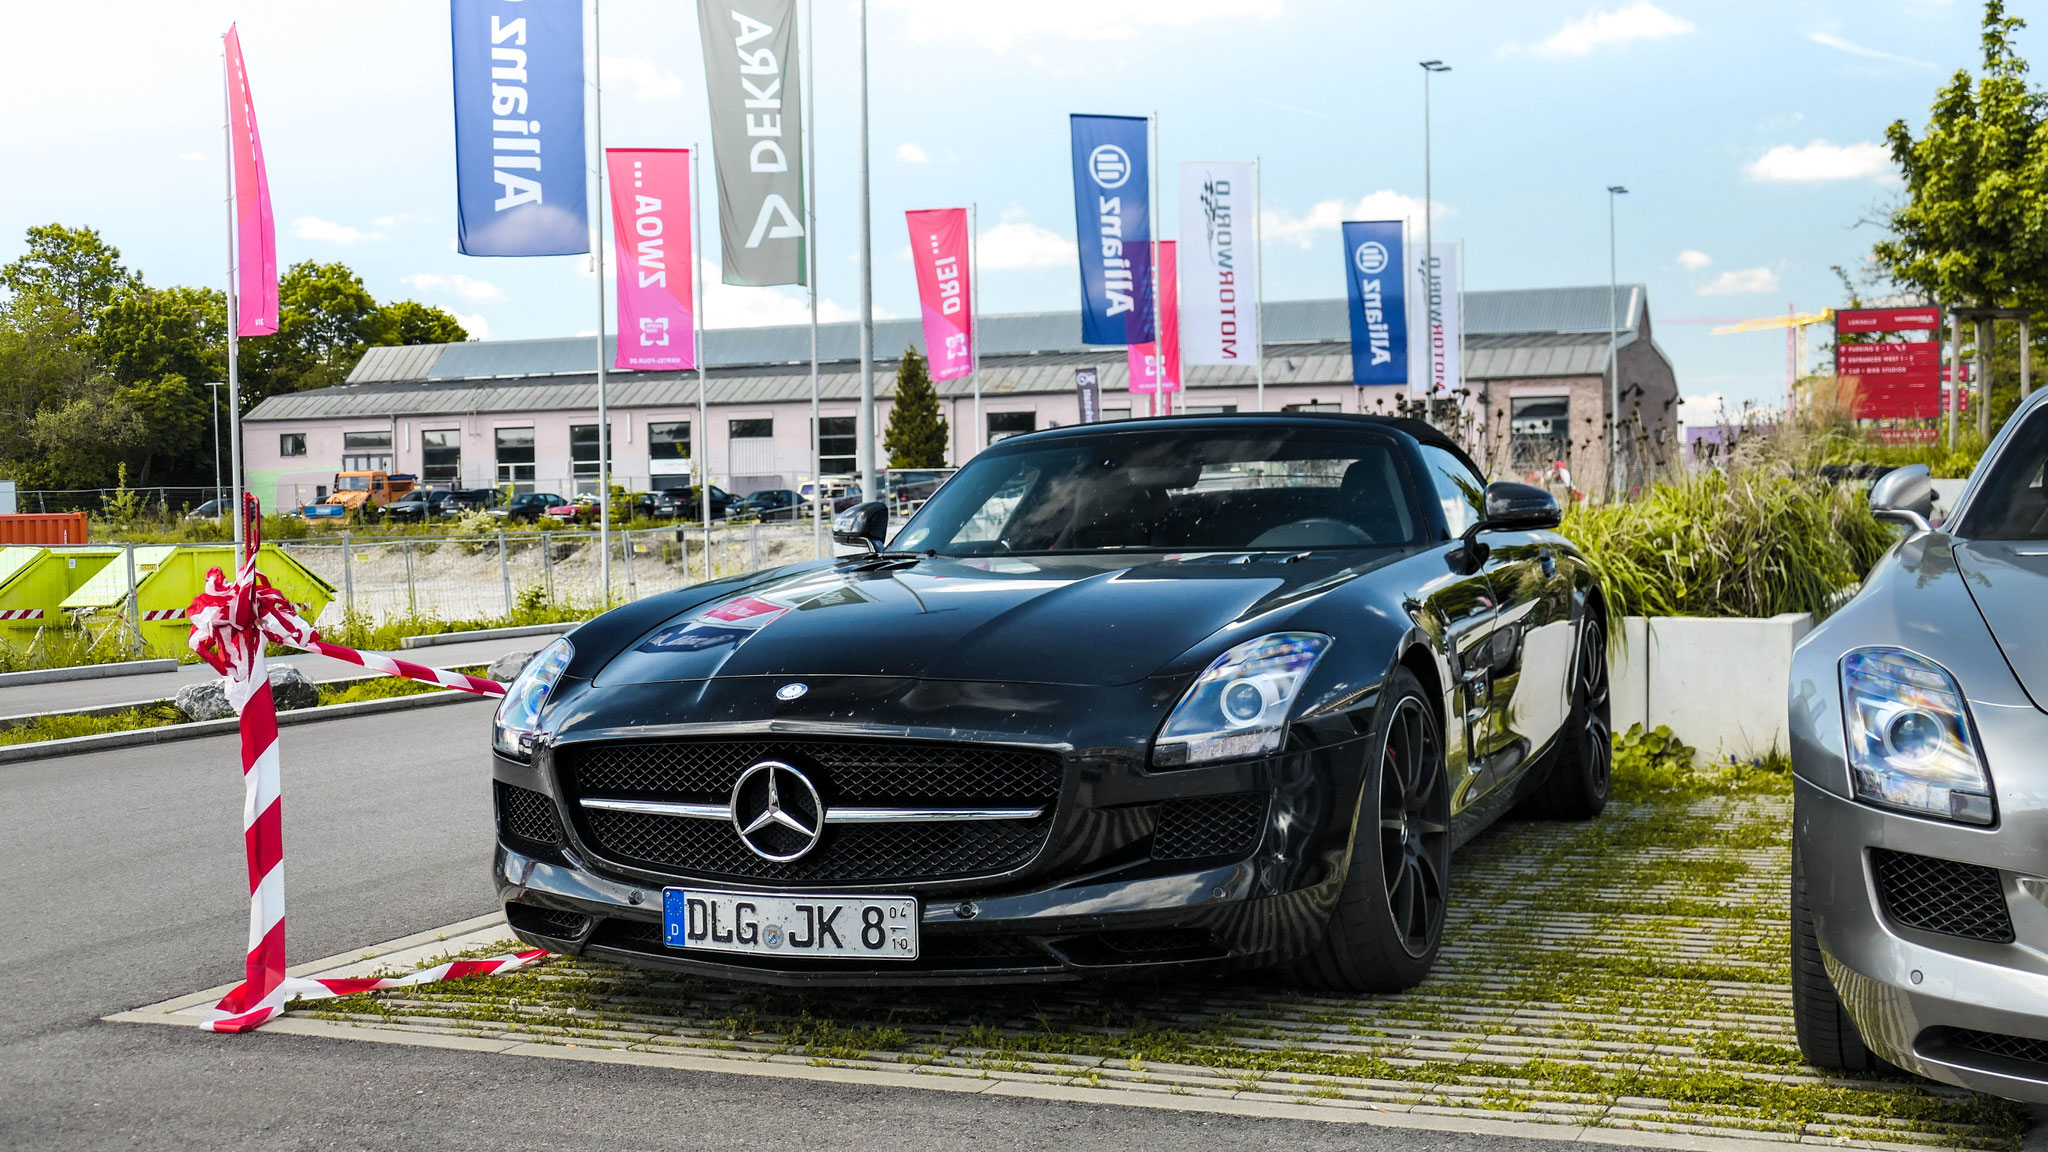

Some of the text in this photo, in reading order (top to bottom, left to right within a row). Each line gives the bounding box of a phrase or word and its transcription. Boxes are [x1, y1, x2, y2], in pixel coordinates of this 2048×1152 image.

[889, 906, 907, 919] 04
[671, 923, 679, 936] D
[687, 897, 886, 950] DLG JK 8
[892, 936, 908, 950] 10
